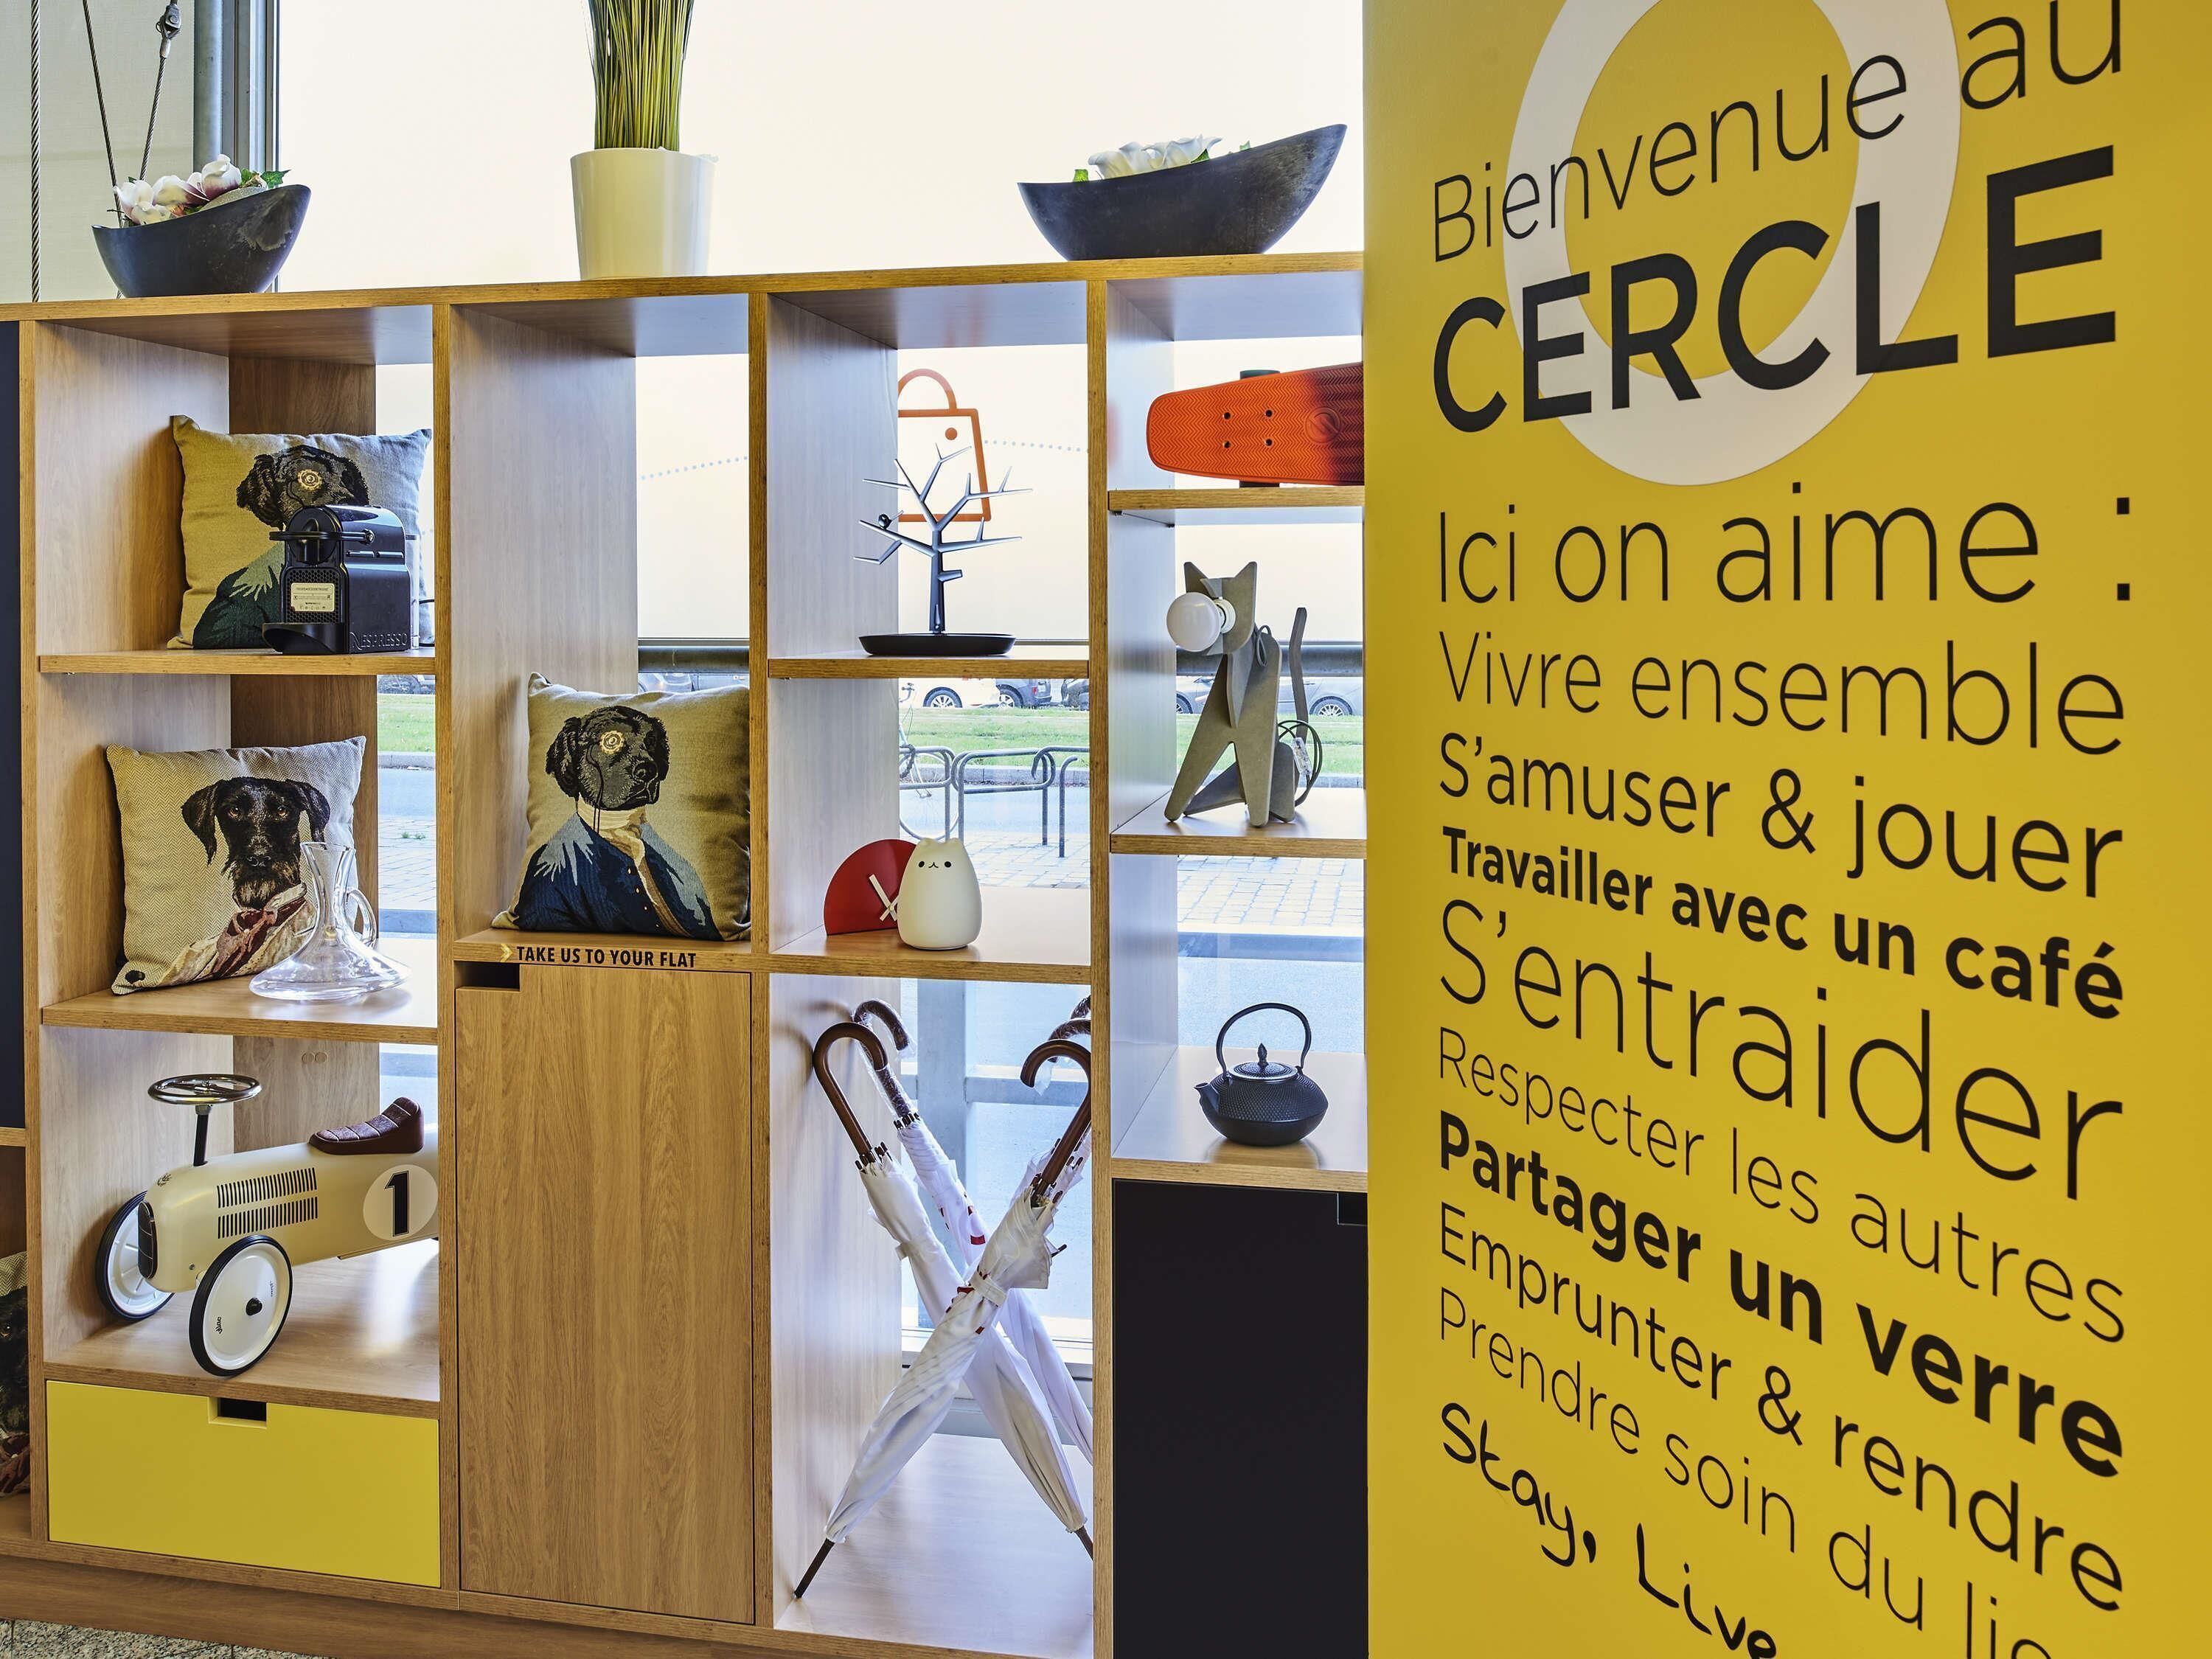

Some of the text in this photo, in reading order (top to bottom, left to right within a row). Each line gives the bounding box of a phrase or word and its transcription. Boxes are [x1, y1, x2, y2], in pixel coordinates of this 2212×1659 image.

[1434, 0, 2121, 262] Bienvenue au
[1433, 145, 2115, 433] CERCLE
[349, 632, 408, 650] NESPRESSO
[1440, 481, 2130, 603] Ici on aime :
[1439, 631, 2124, 755] Vivre ensemble
[1442, 825, 2124, 1019] Travailler avec un café
[1761, 768, 1816, 854] &
[1847, 776, 2123, 898] jouer
[517, 947, 697, 967] TAKE US TO YOUR FLAT
[384, 1170, 409, 1237] 1
[1440, 1026, 2124, 1343] Respecter les autres
[1440, 1110, 2122, 1478] Partager un verre
[1441, 1202, 2122, 1611] Emprunter & rendre
[1441, 1287, 1640, 1455] Prendre
[1664, 1433, 1795, 1553] soin
[1829, 1524, 1923, 1631] du
[1441, 1402, 1776, 1659] Stay, Live
